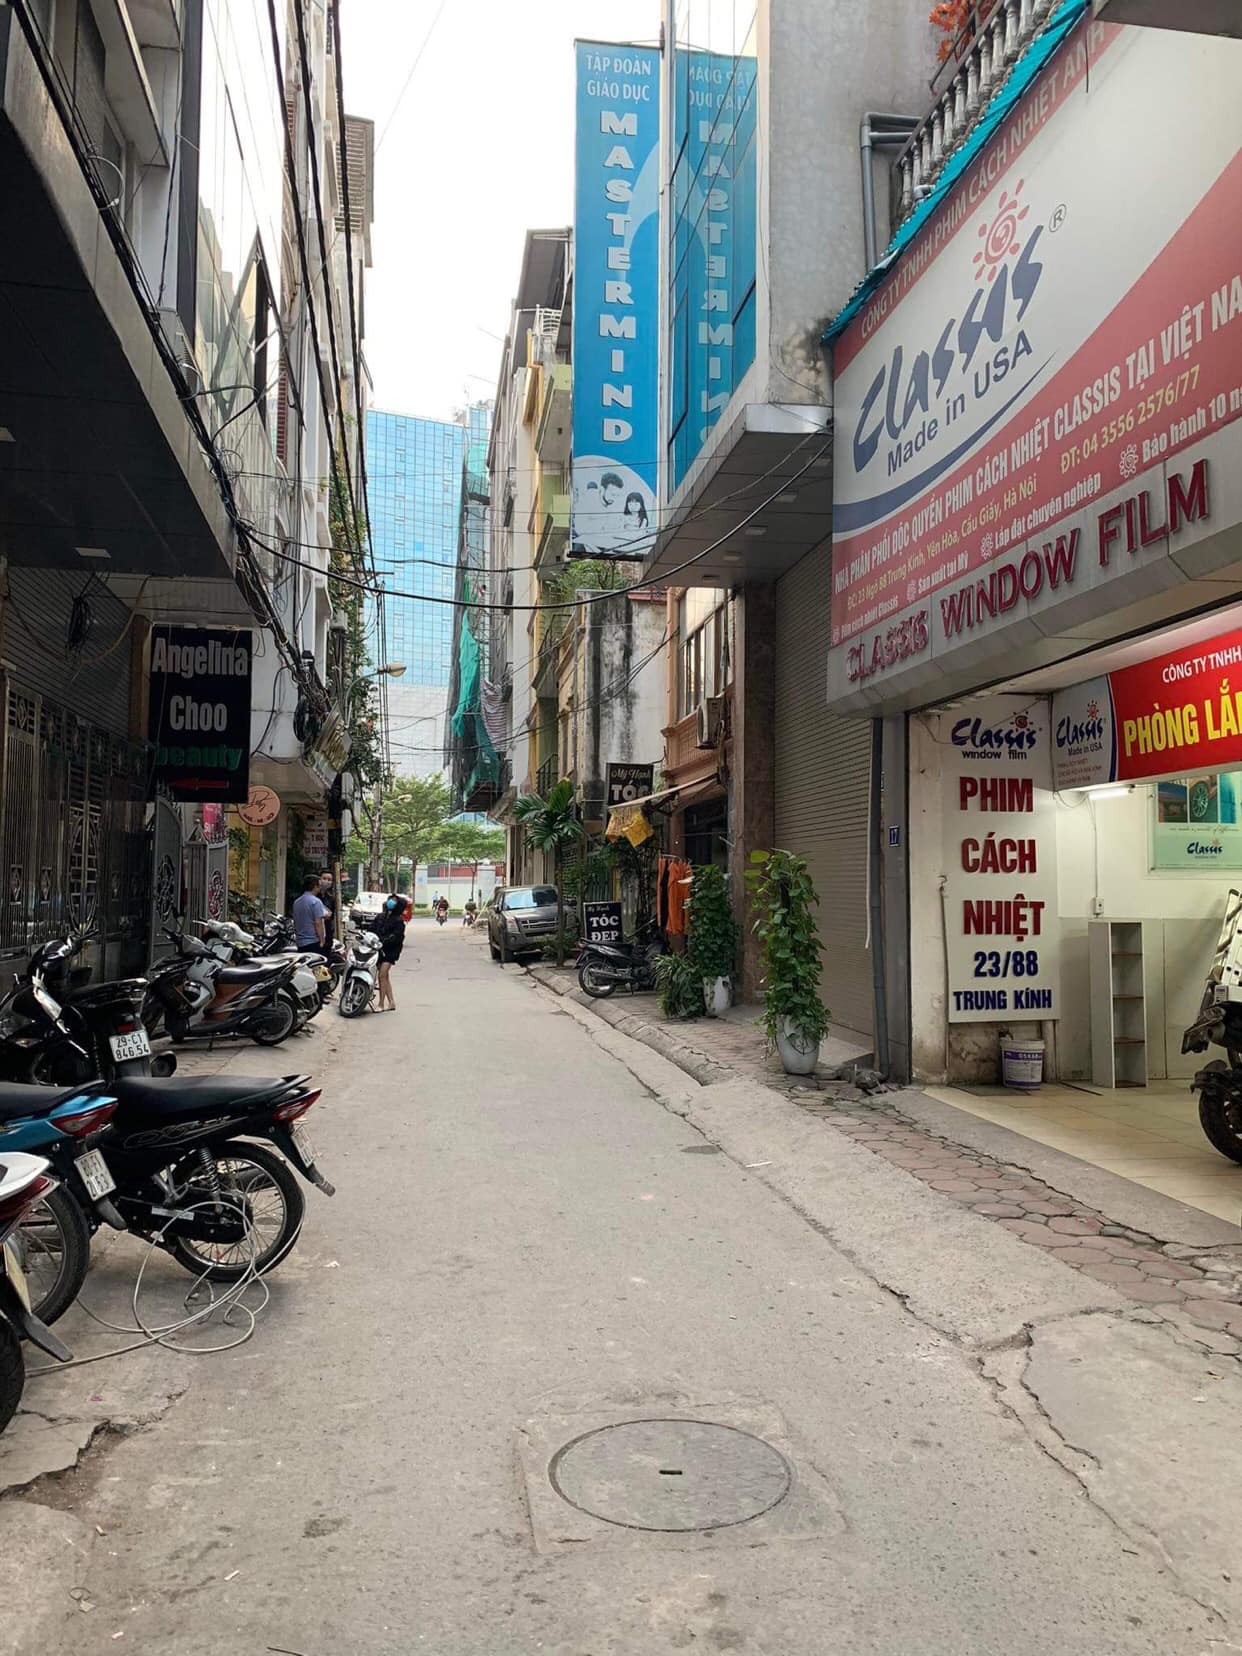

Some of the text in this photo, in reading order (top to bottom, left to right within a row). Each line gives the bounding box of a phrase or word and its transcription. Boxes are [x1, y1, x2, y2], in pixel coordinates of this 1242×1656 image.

[585, 53, 651, 76] TẬP ĐOÀN
[587, 76, 650, 102] GIÁO DỤC
[861, 295, 887, 338] CÔNG
[889, 277, 901, 304] TY
[902, 234, 932, 288] TNHH
[935, 192, 966, 248] PHIM
[969, 136, 1006, 203] CÁCH
[1011, 69, 1058, 153] NHIỆT
[887, 329, 1032, 476] Made in USA
[1060, 364, 1200, 474] ĐT: 04 3556 2576/77
[1142, 432, 1168, 463] Bảo
[1170, 407, 1206, 447] hành
[1208, 392, 1226, 423] 10
[835, 562, 849, 594] NHÀ
[850, 549, 871, 584] PHÂN
[872, 528, 890, 569] PHỐI
[892, 521, 909, 556] ĐỘC
[912, 494, 942, 542] QUYỀN
[945, 474, 973, 518] PHIM
[976, 449, 1008, 497] CÁCH
[1011, 415, 1049, 472] NHIỆT
[1054, 365, 1121, 441] CLASSIS
[1126, 338, 1155, 390] TẠI
[1160, 304, 1205, 365] VIỆT
[1027, 498, 1061, 530] chuyên
[1064, 472, 1101, 508] nghiệp
[888, 564, 906, 585] Trung
[926, 541, 940, 561] Yên
[1004, 489, 1017, 511] Hà
[1019, 473, 1037, 501] Nội
[940, 527, 1081, 640] WINDOW
[1098, 458, 1208, 567] FILM
[151, 637, 248, 679] Angelina
[1162, 645, 1241, 683] CÔNG TY TNHH
[169, 695, 227, 731] Choo
[1056, 715, 1103, 748] Classis
[1123, 702, 1199, 757] PHÒNG
[951, 717, 1036, 749] Classis
[1090, 742, 1103, 753] USA
[962, 749, 1027, 760] window film
[959, 776, 1033, 812] PHIM
[961, 832, 1036, 873] CÁCH
[589, 913, 619, 928] TÓC
[963, 893, 1044, 941] NHIỆT
[974, 950, 1039, 978] 23/88
[953, 987, 1052, 1010] TRUNG KÍNH
